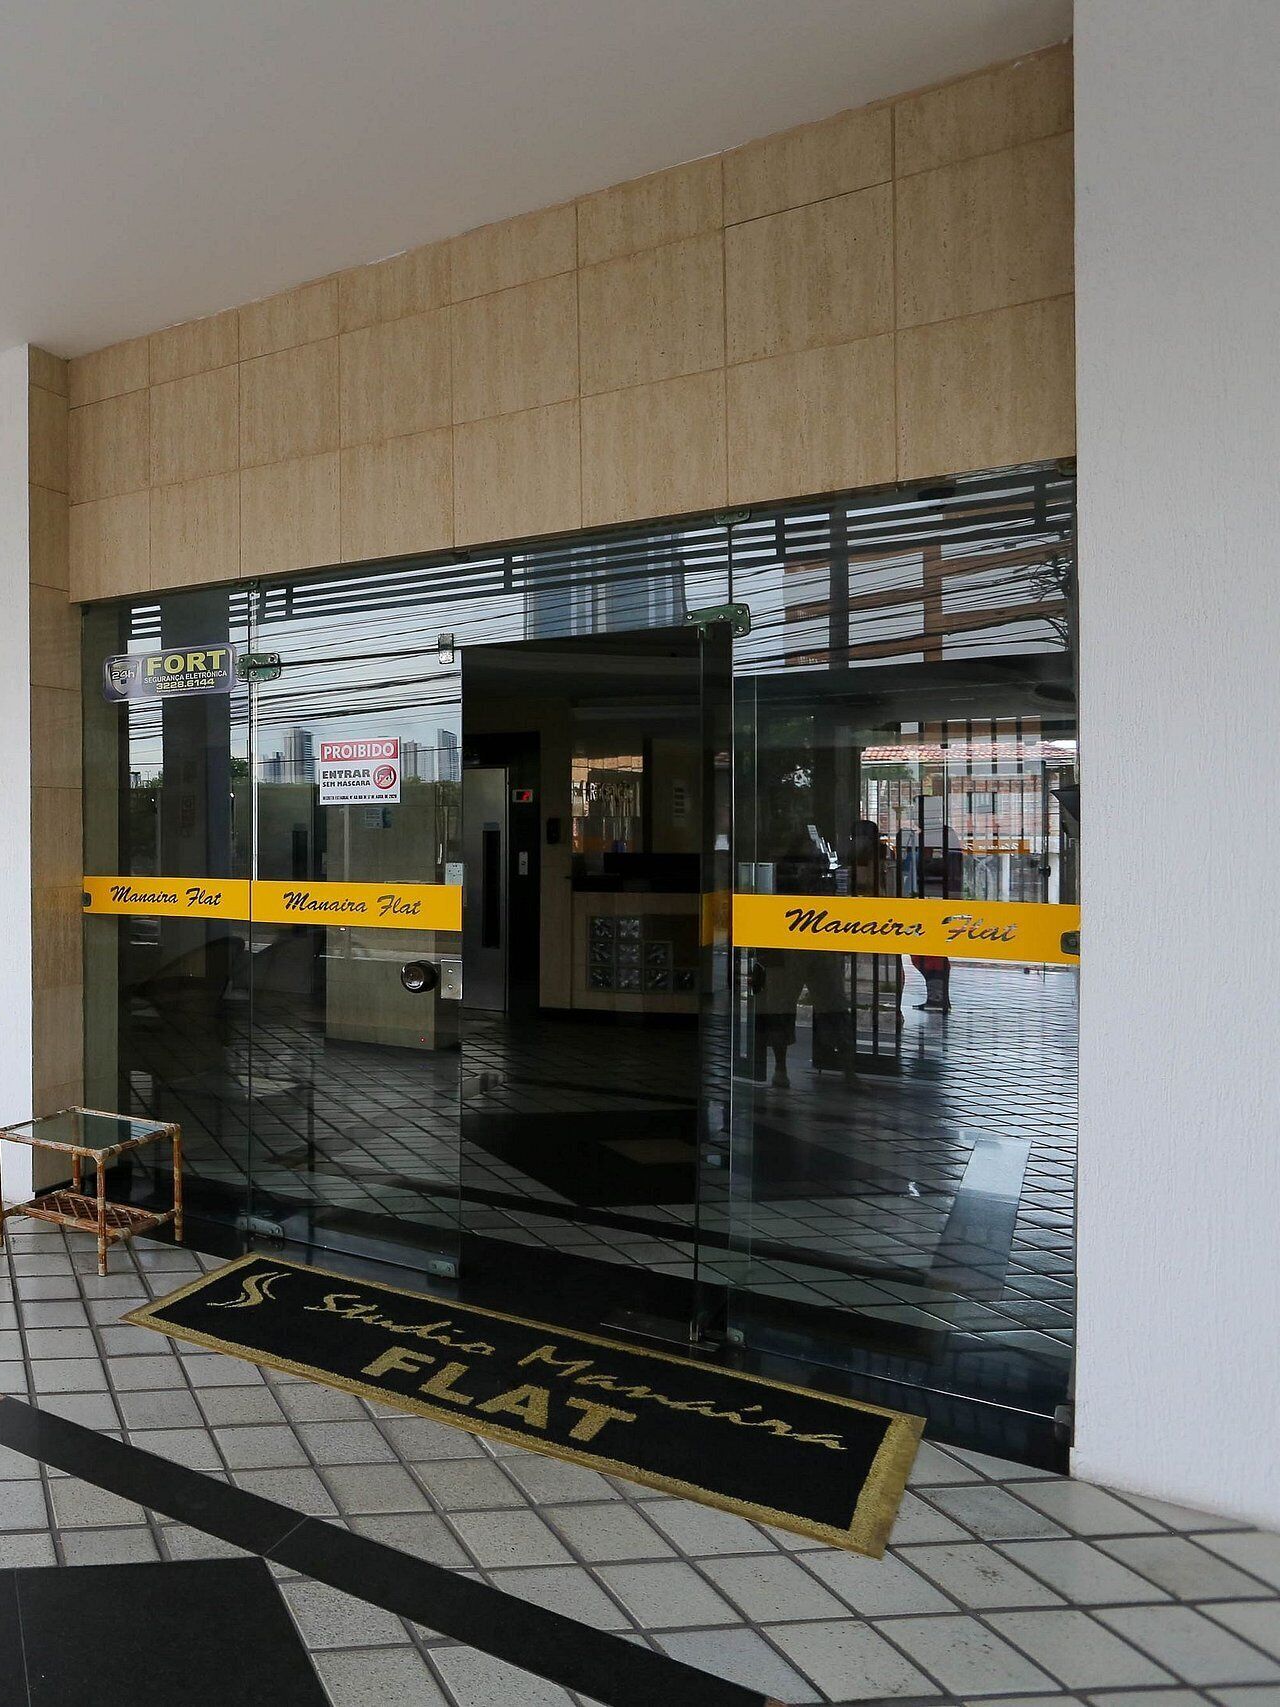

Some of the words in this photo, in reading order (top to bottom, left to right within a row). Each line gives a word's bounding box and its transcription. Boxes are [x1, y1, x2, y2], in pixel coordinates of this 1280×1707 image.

[146, 650, 226, 676] FORT
[111, 669, 135, 680] 24h
[144, 674, 185, 684] SEGURANÇA
[185, 669, 227, 680] ELETRÔNICA
[156, 678, 215, 690] 3228.6144
[323, 742, 395, 760] PROIBIDO
[322, 769, 371, 780] ENTRAR
[110, 886, 179, 905] Manaira
[185, 887, 223, 907] Flat
[283, 892, 368, 914] Manaira
[376, 894, 423, 917] Flat
[785, 908, 926, 936] Manaira
[941, 914, 1018, 942] Flat
[304, 1292, 496, 1357] Studio
[517, 1345, 849, 1451] Manaira
[361, 1346, 637, 1443] FLAT
